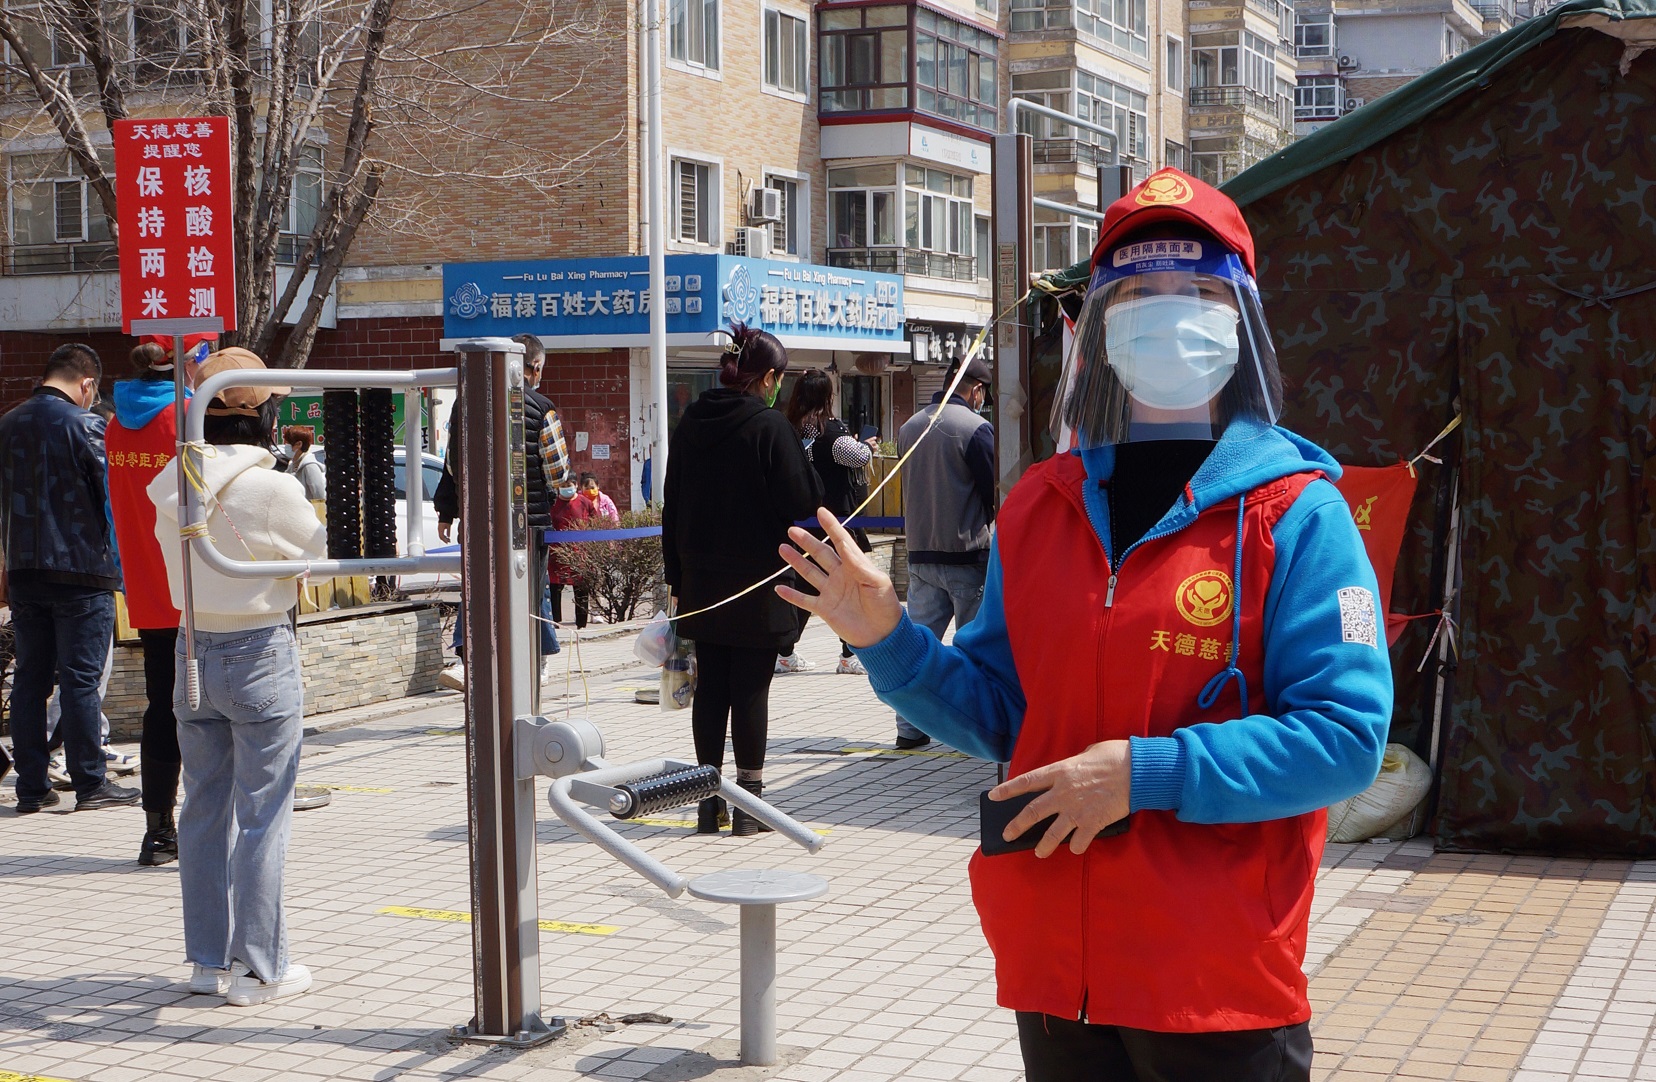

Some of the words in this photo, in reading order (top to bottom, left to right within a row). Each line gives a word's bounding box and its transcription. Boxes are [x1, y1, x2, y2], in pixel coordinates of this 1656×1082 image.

[130, 121, 213, 140] 天德慈善
[143, 143, 203, 159] 提醒您
[136, 166, 168, 318] 保持两米
[183, 164, 216, 318] 核酸检测
[1119, 242, 1194, 260] 医用隔离面罩
[523, 272, 534, 281] Fu
[537, 272, 547, 281] Lu
[551, 272, 564, 281] Bai
[568, 270, 586, 281] Xing
[589, 269, 629, 280] Pharmacy
[784, 268, 792, 280] Fu
[793, 269, 801, 281] Lu
[802, 270, 812, 283] Bai
[813, 271, 826, 286] Xing
[827, 272, 853, 288] Pharmacy
[760, 284, 878, 330] 福禄百姓大药房
[905, 322, 933, 333] Taozi
